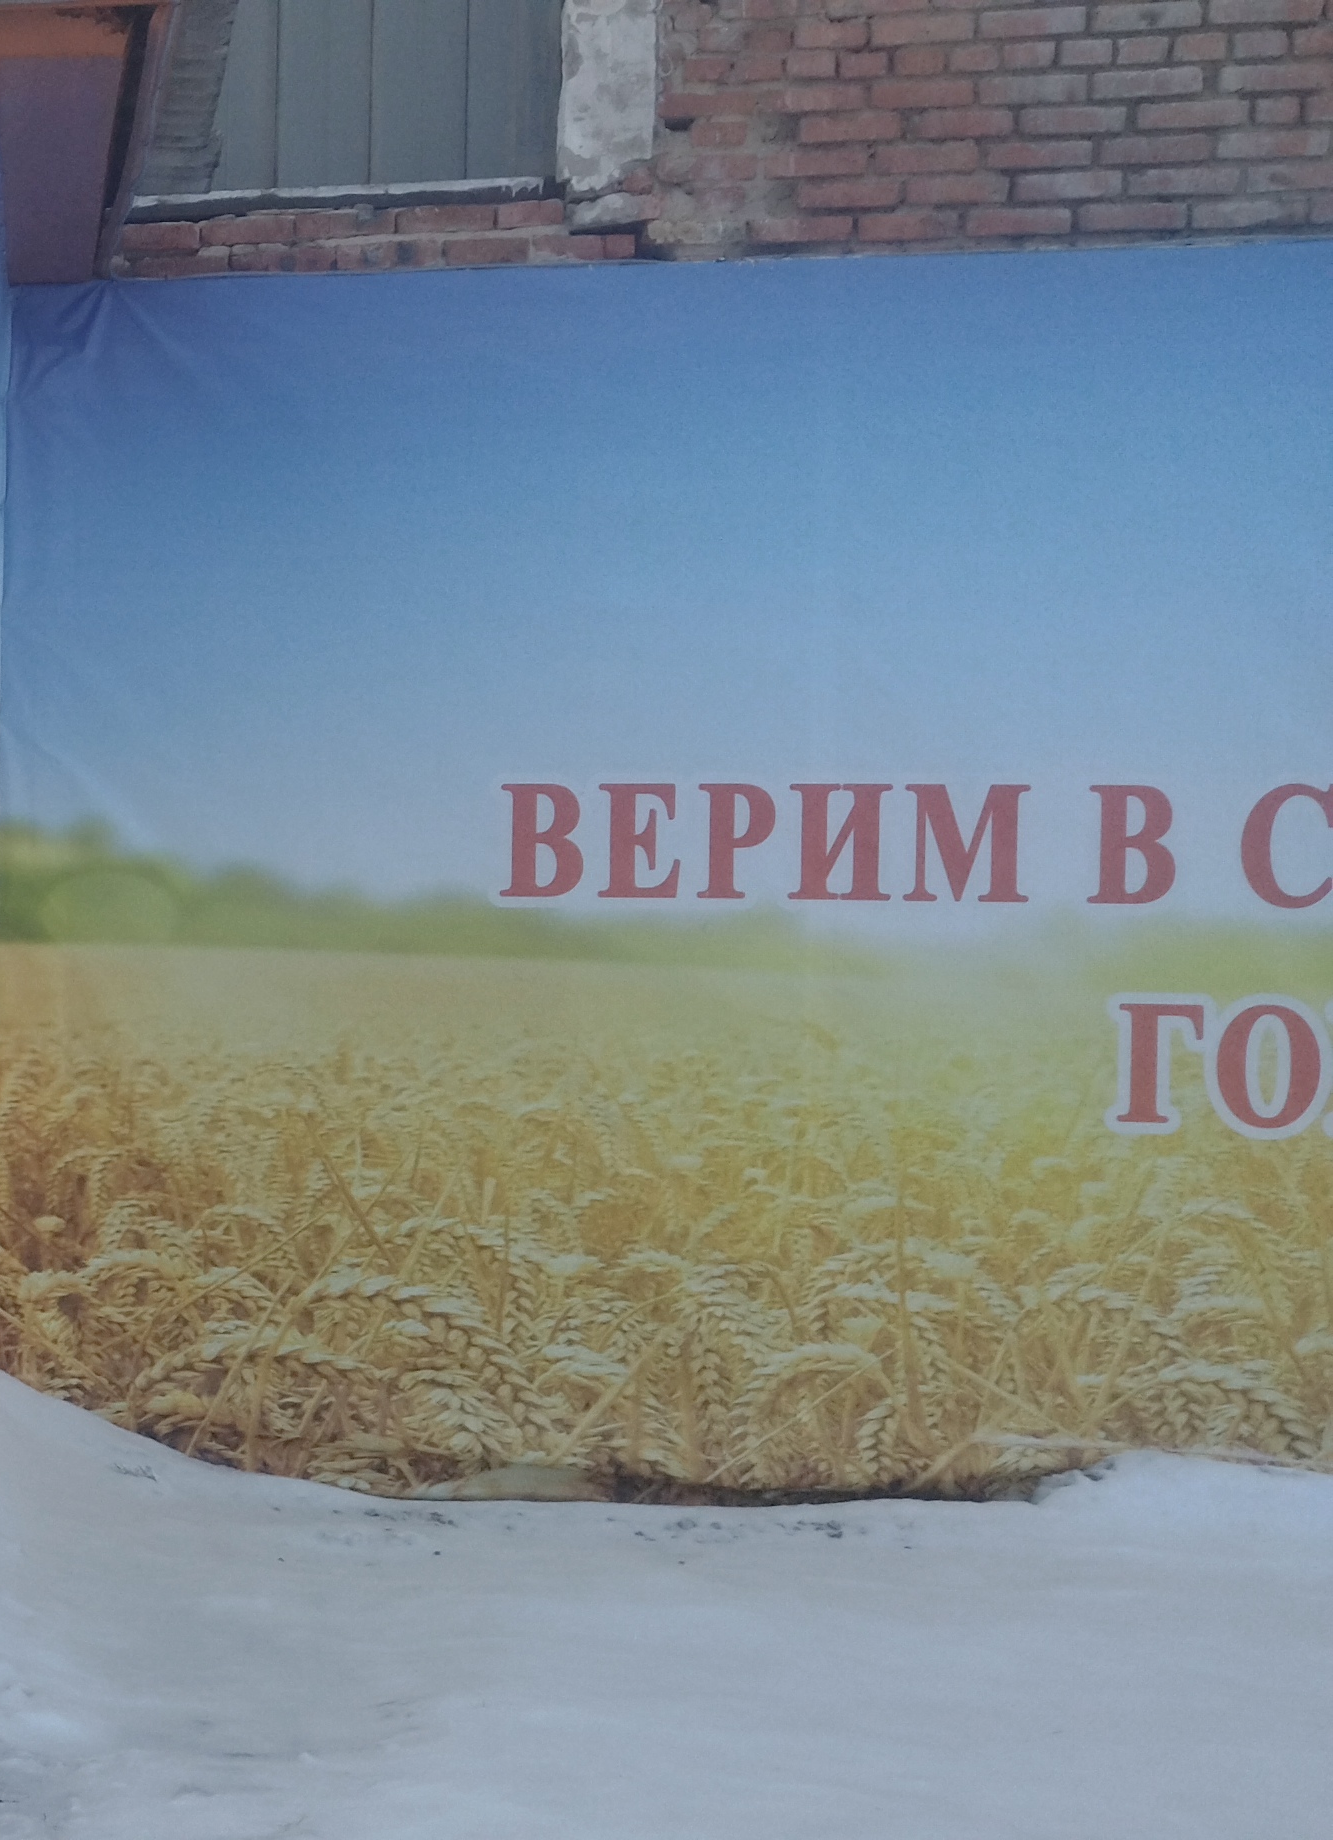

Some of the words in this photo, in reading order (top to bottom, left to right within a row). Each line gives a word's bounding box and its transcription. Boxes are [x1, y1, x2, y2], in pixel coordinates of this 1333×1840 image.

[499, 783, 1031, 902] ВЕРИМ
[1087, 784, 1176, 904] В
[1117, 1002, 1323, 1128] ГО
